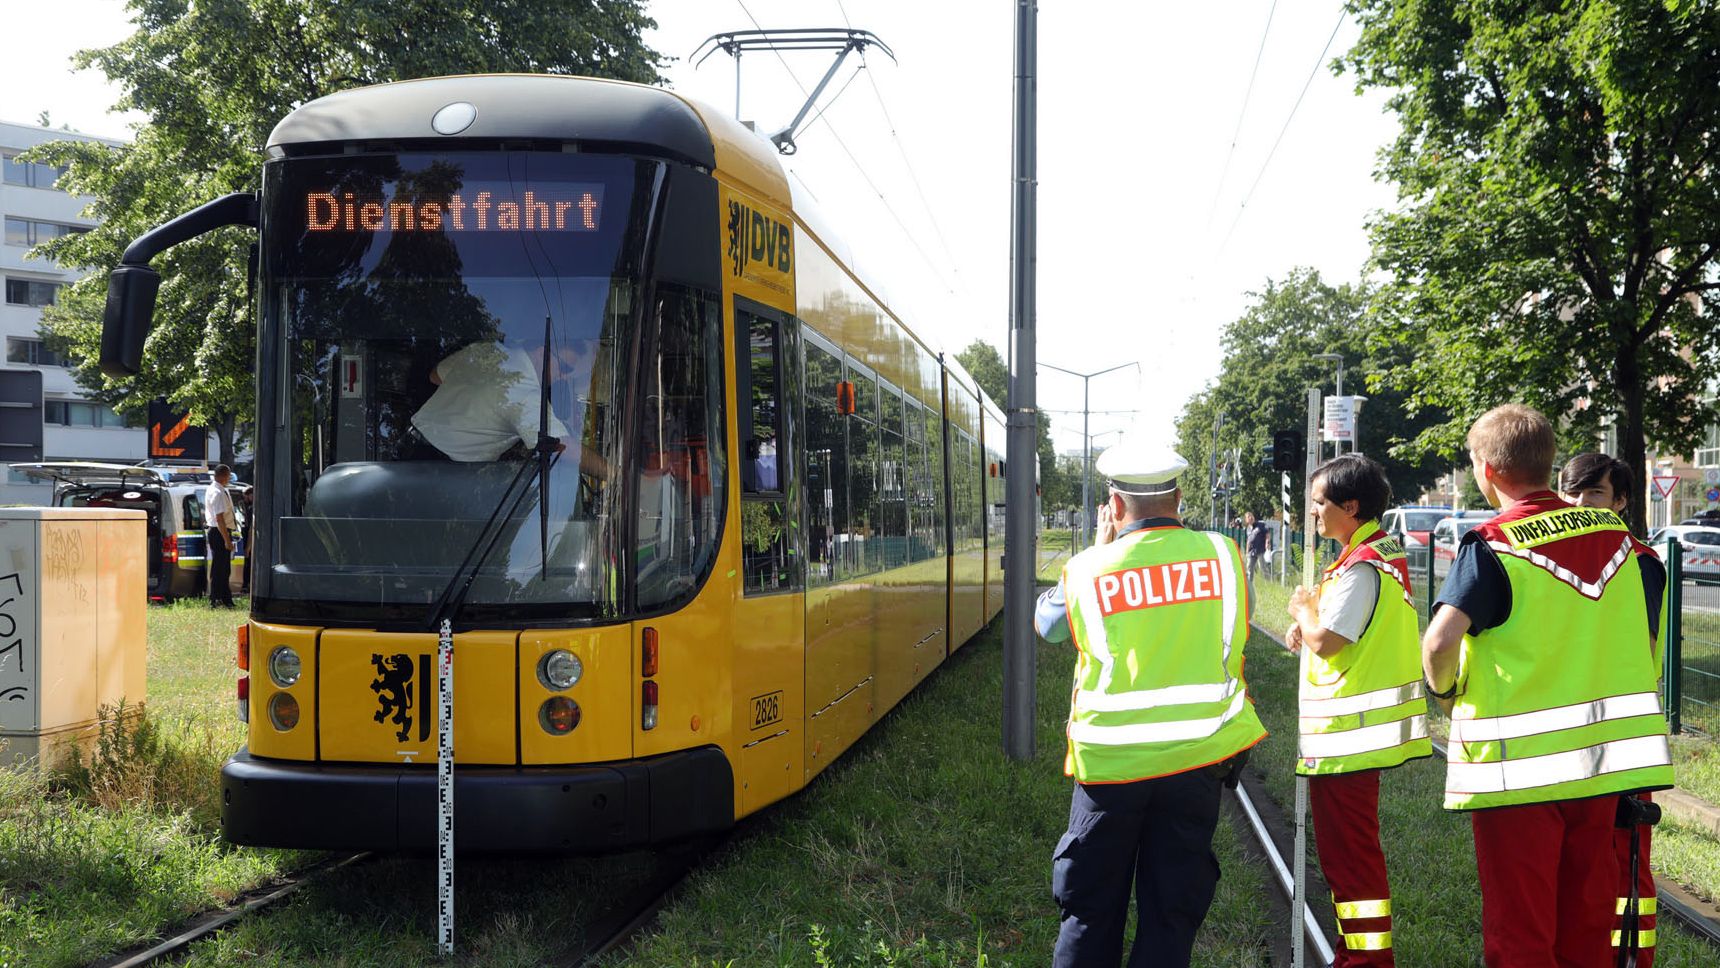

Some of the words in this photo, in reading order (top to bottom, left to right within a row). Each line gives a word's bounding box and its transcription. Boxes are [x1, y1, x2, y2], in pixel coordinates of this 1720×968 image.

[307, 191, 598, 231] Dienstfahrt
[751, 209, 791, 274] DVB
[1098, 560, 1221, 613] POLIZEI
[755, 695, 778, 725] 2826
